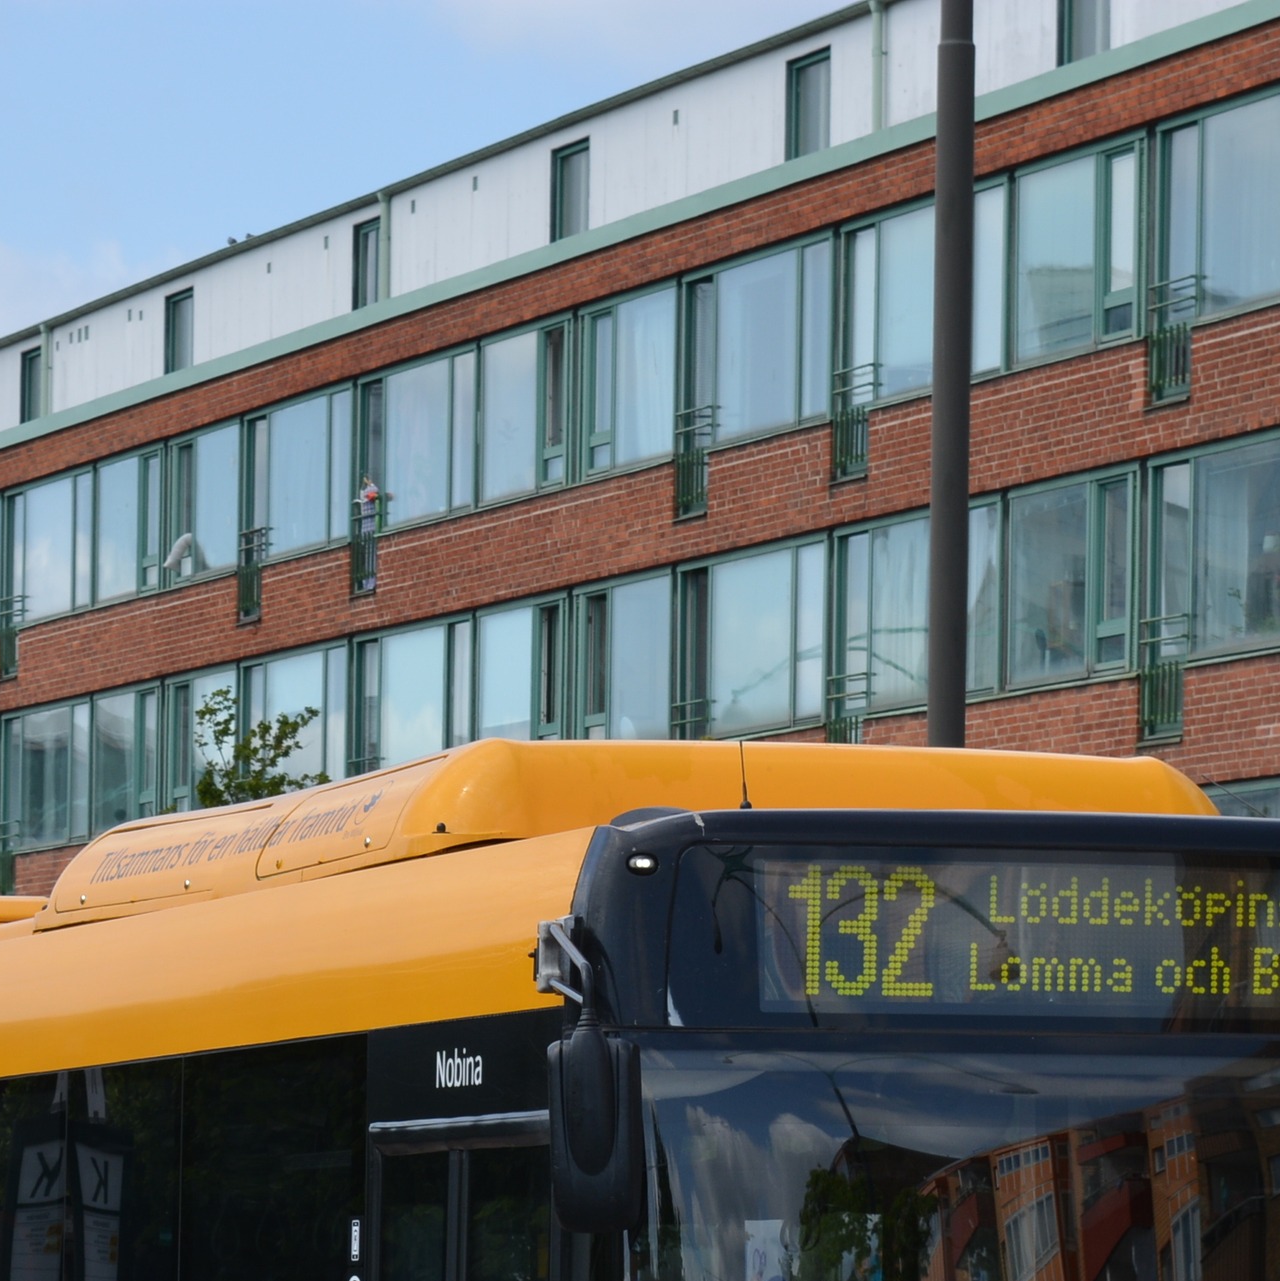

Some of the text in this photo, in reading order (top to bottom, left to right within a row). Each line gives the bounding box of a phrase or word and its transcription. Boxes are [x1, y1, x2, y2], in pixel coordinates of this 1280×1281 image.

[90, 843, 190, 885] Tillsammans
[181, 830, 217, 867] för
[207, 833, 238, 861] en
[287, 798, 357, 843] framtid
[788, 864, 935, 997] 132
[970, 942, 1132, 993] Lomma
[1155, 946, 1231, 995] och
[435, 1047, 482, 1089] Nobina
